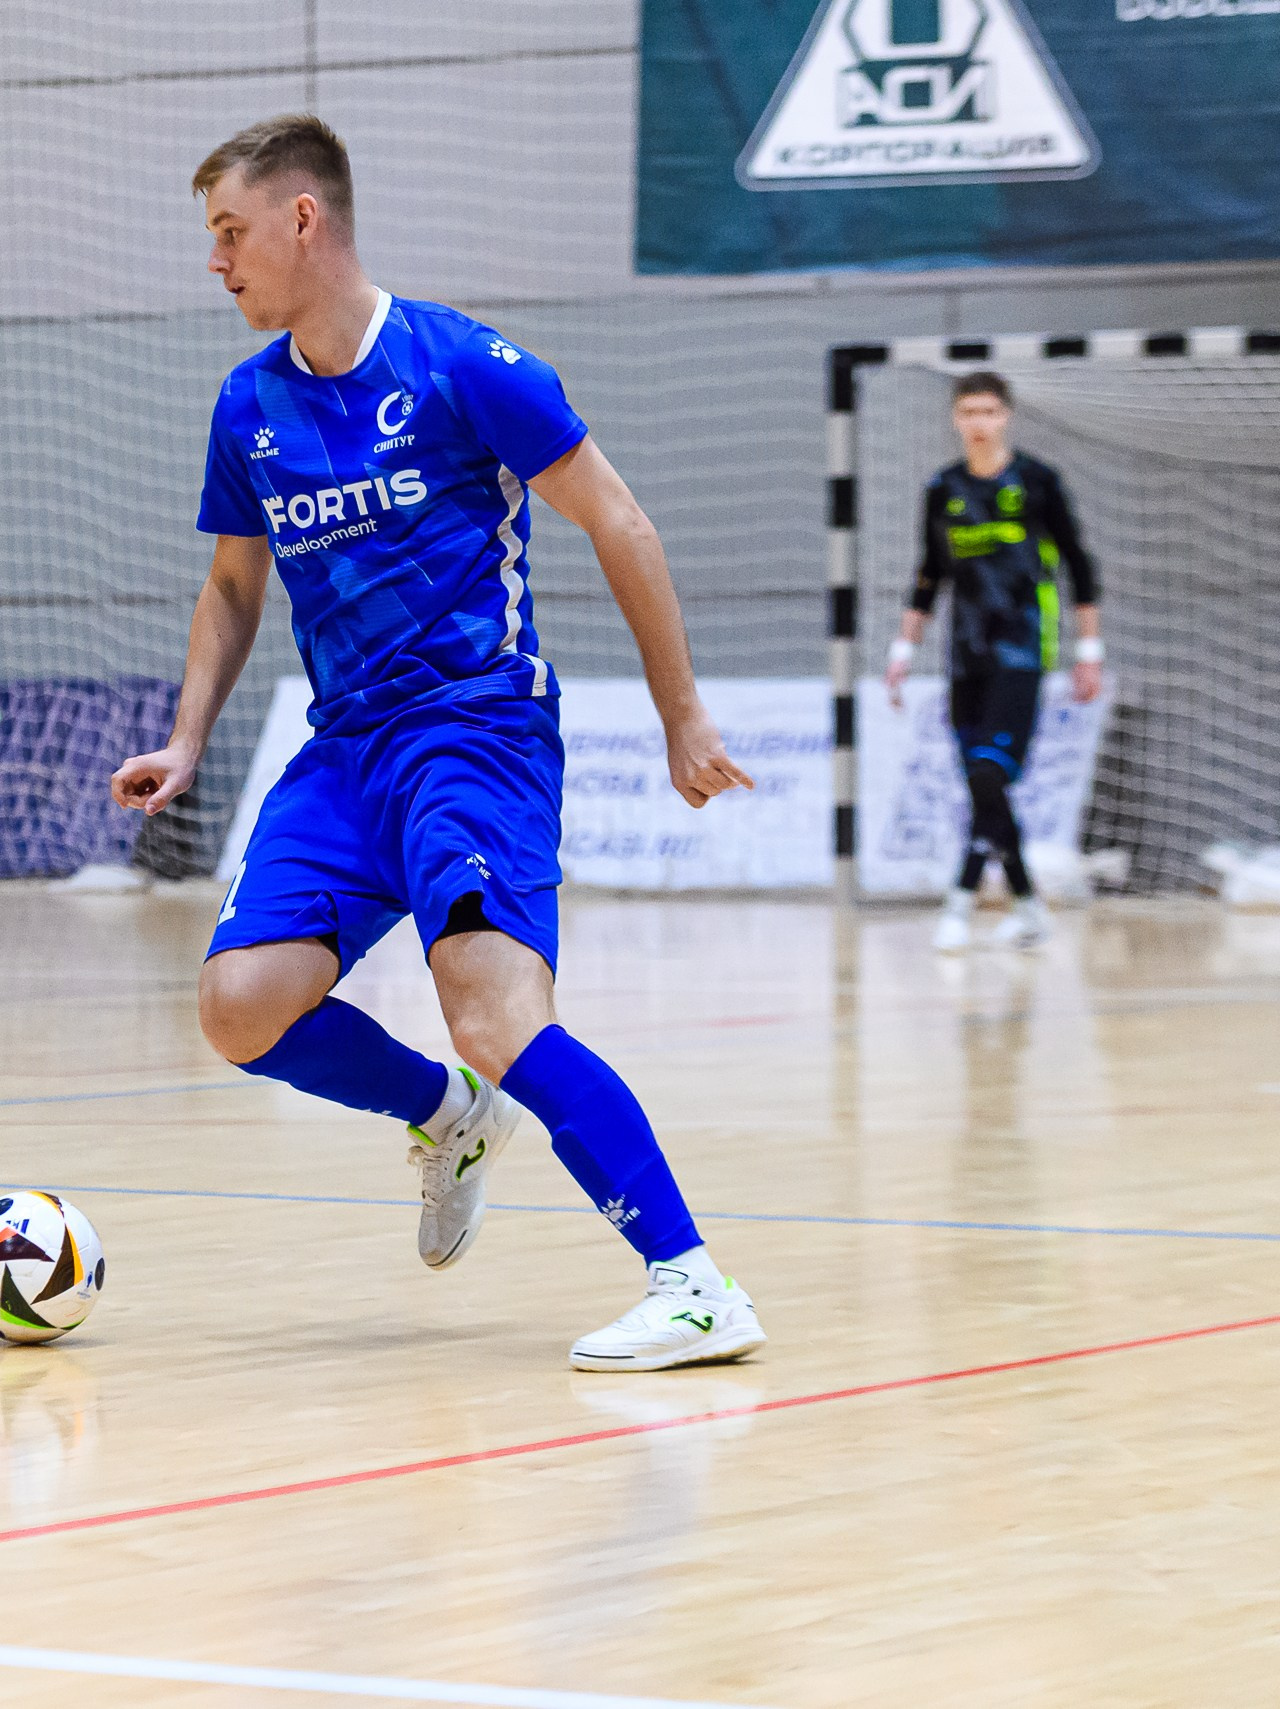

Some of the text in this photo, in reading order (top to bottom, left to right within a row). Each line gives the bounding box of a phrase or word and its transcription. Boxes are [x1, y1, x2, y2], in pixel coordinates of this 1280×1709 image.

[250, 448, 279, 460] KELME
[262, 469, 427, 533] FORTIS
[276, 519, 377, 558] Development
